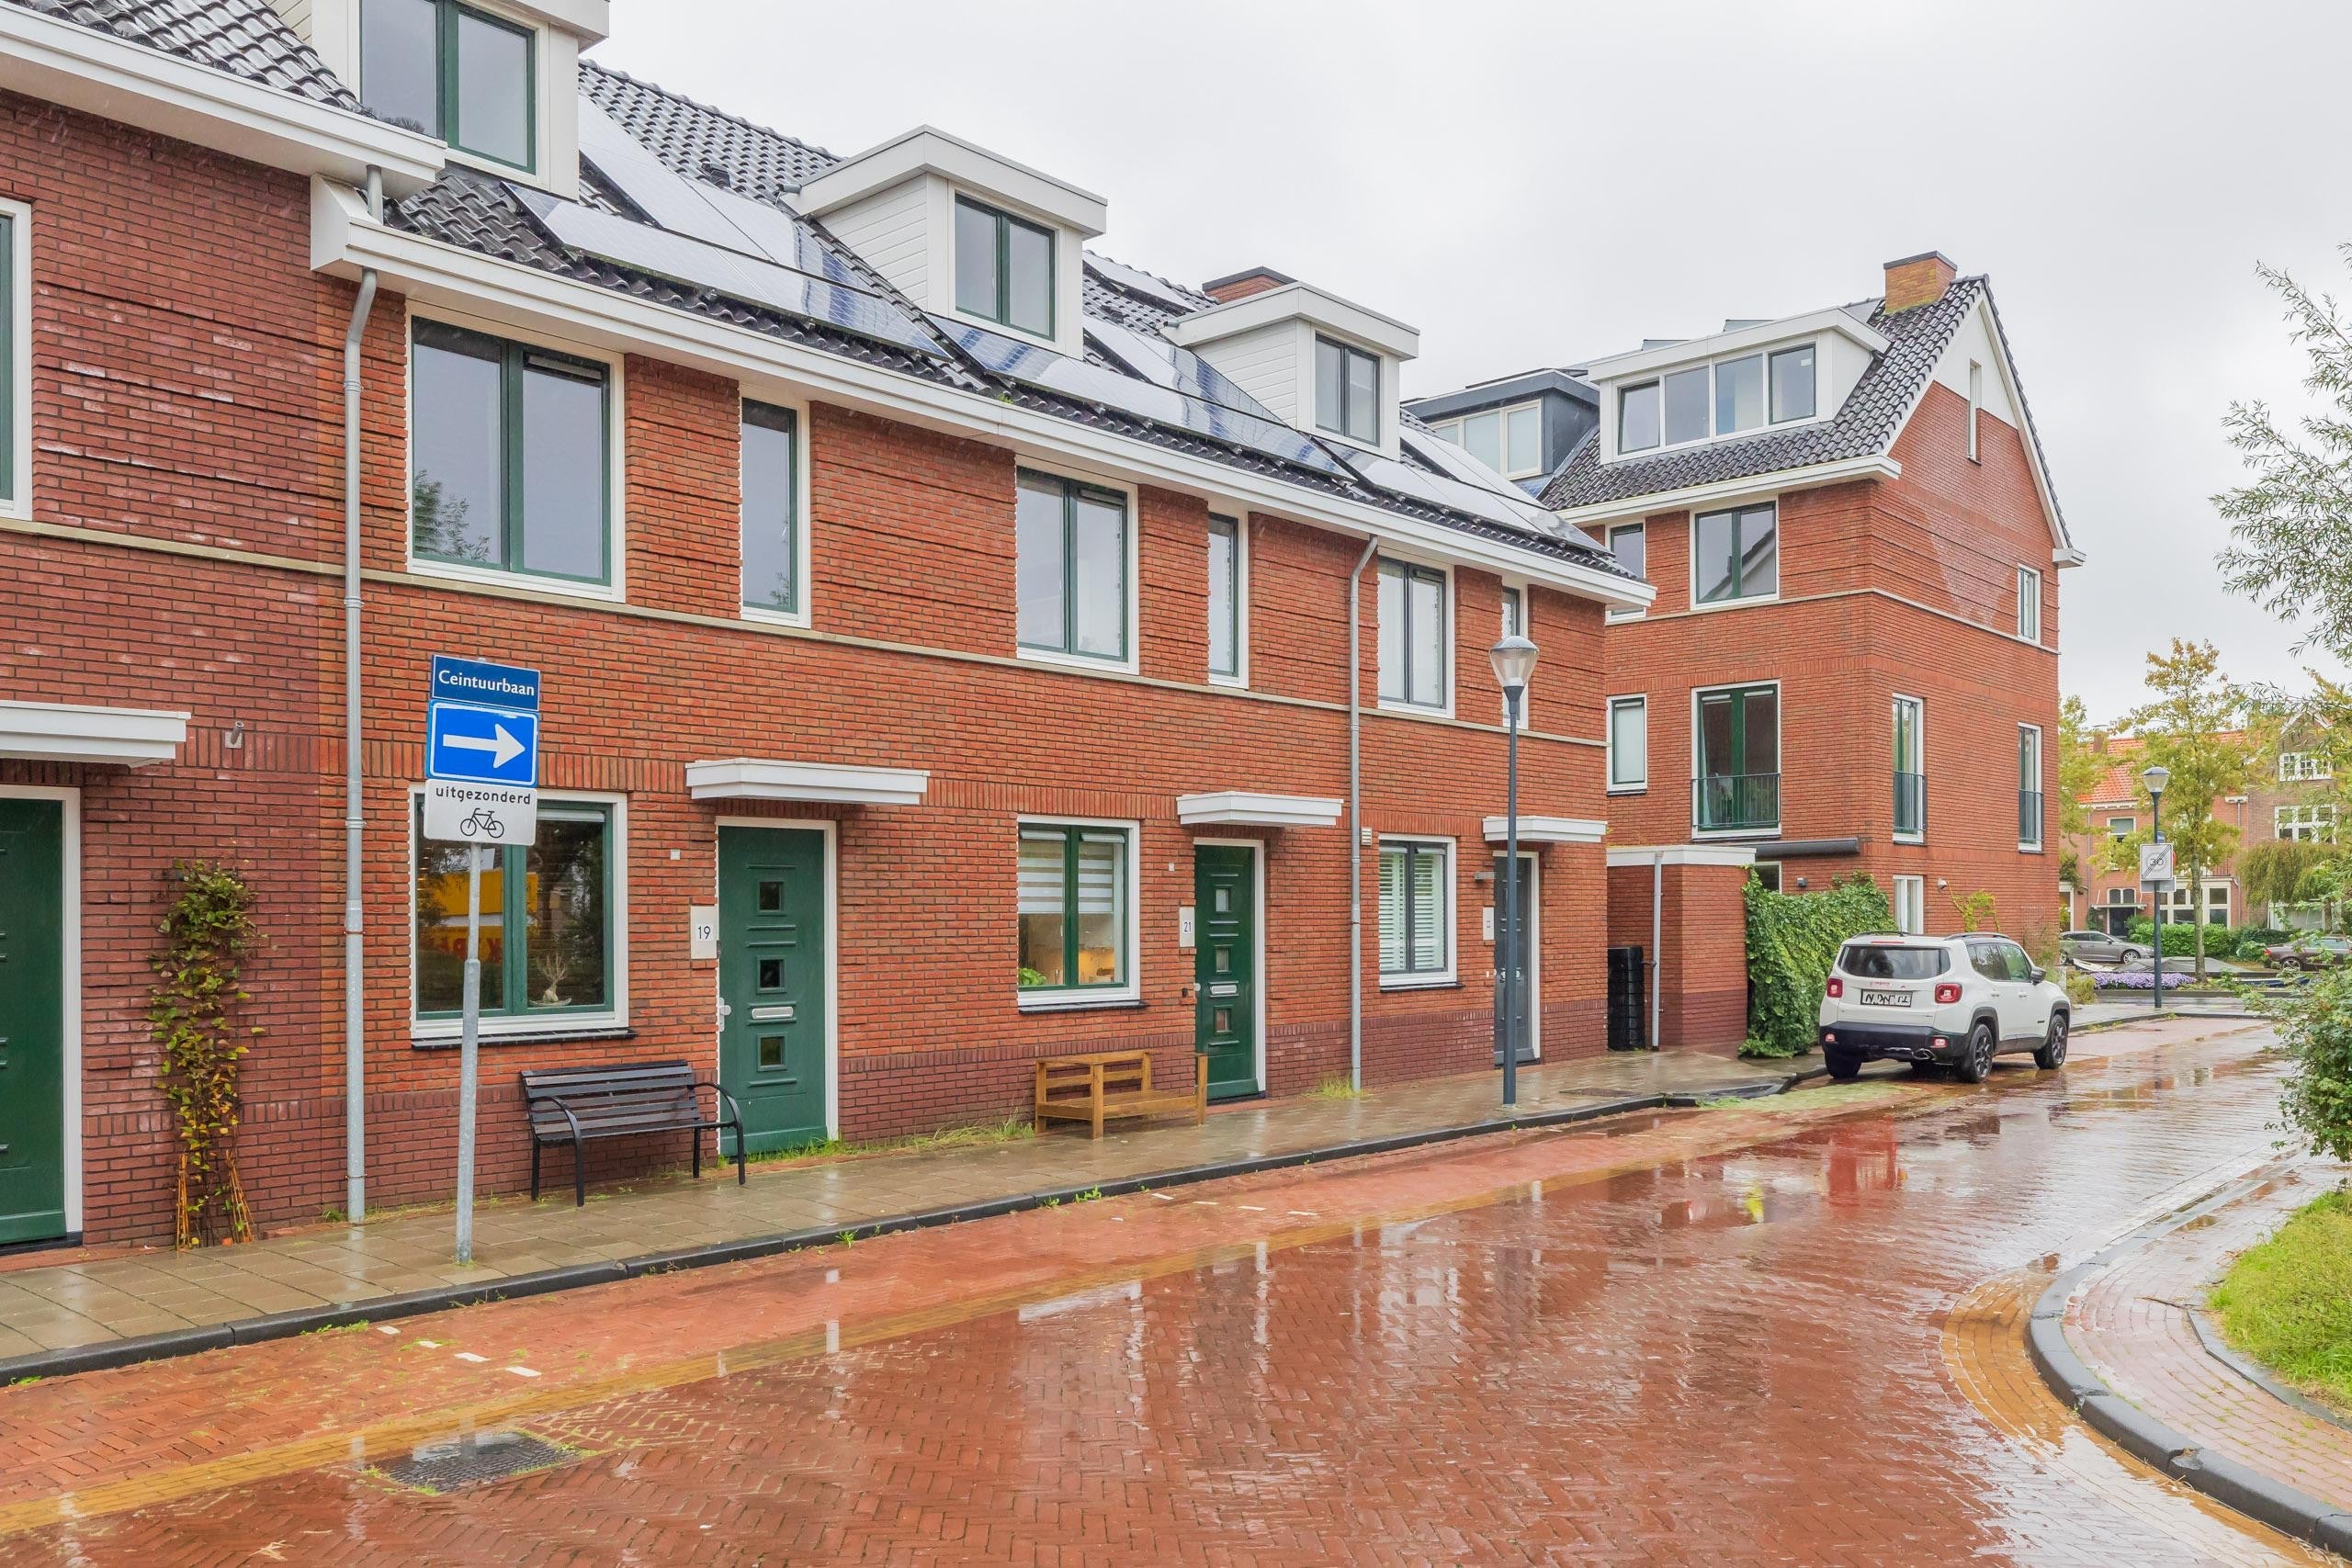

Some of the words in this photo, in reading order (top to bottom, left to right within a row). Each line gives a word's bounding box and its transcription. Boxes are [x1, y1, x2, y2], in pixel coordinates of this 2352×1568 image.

[438, 671, 535, 696] Ceintuurbaan
[436, 786, 531, 805] uitgezonderd
[2149, 858, 2164, 866] 30
[697, 925, 711, 940] 19
[1183, 921, 1192, 932] 21
